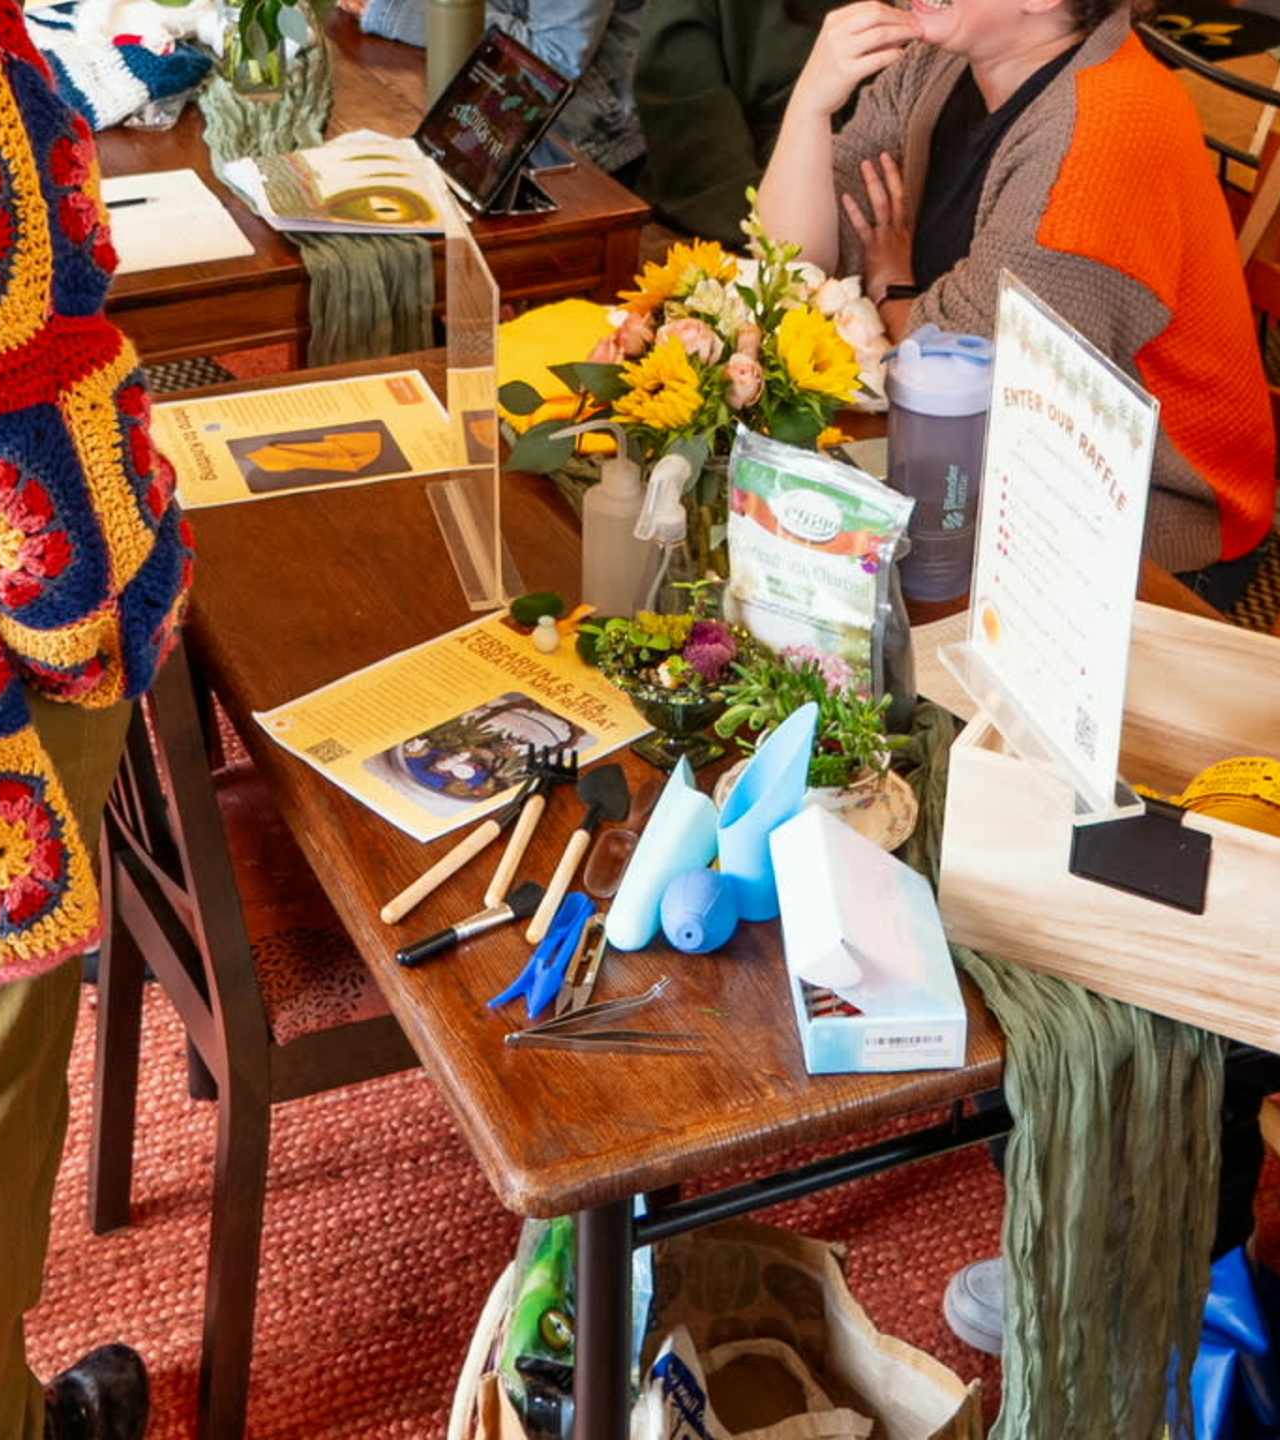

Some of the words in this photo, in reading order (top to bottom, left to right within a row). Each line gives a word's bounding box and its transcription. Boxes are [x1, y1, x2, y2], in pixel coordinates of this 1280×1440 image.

[1004, 386, 1042, 414] ENTER
[1048, 404, 1074, 437] OUR
[1079, 432, 1128, 512] RAFFLE
